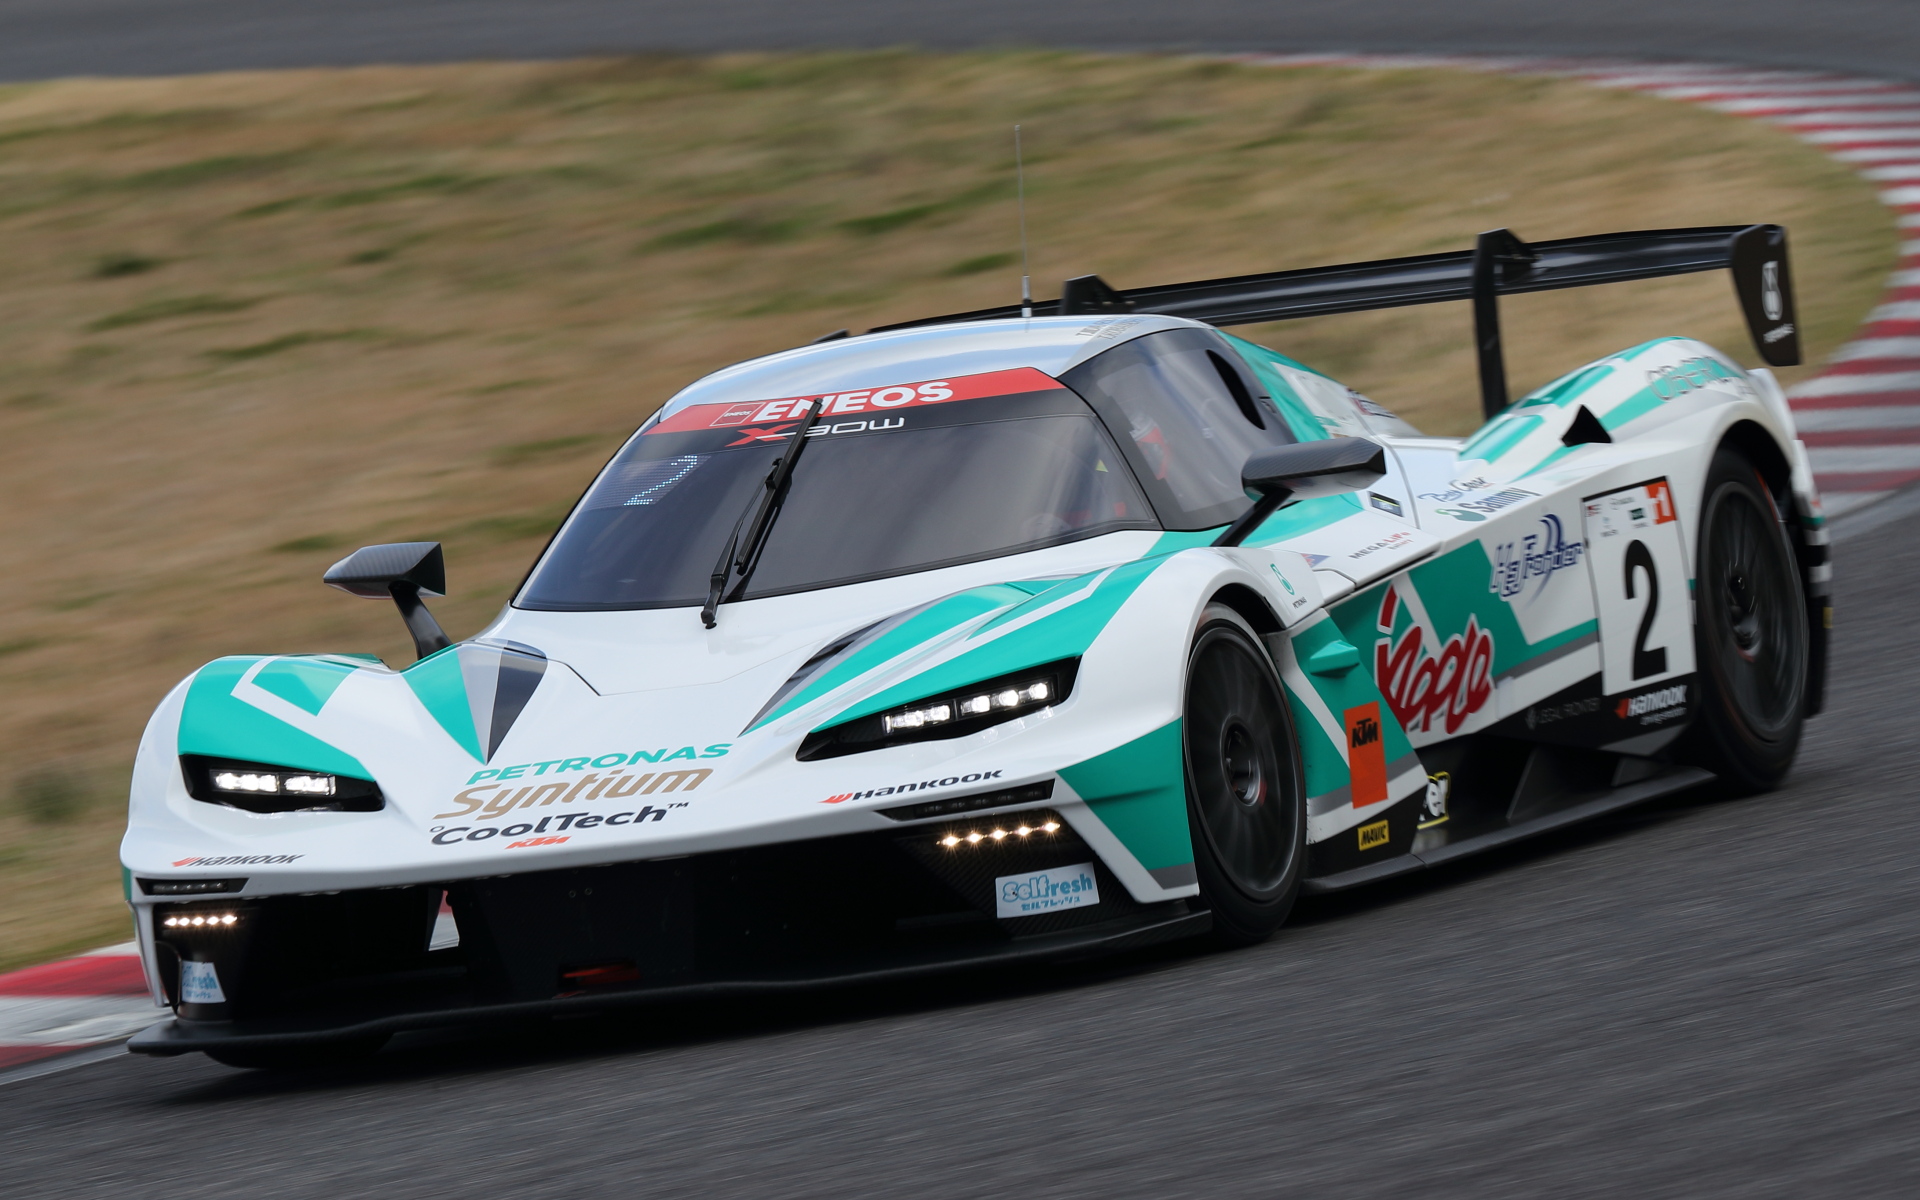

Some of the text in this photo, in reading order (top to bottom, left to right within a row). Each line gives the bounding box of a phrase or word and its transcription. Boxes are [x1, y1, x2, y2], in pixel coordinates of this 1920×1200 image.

[723, 409, 753, 418] ENEOS
[751, 381, 954, 422] ENEOS
[1623, 539, 1669, 681] 2
[1351, 717, 1379, 749] KTM
[466, 743, 734, 785] PETRONAS
[432, 768, 714, 821] Syntium
[504, 835, 571, 849] KTM
[1002, 873, 1093, 903] Selfresh
[1021, 896, 1081, 911] セルフレッシュ
